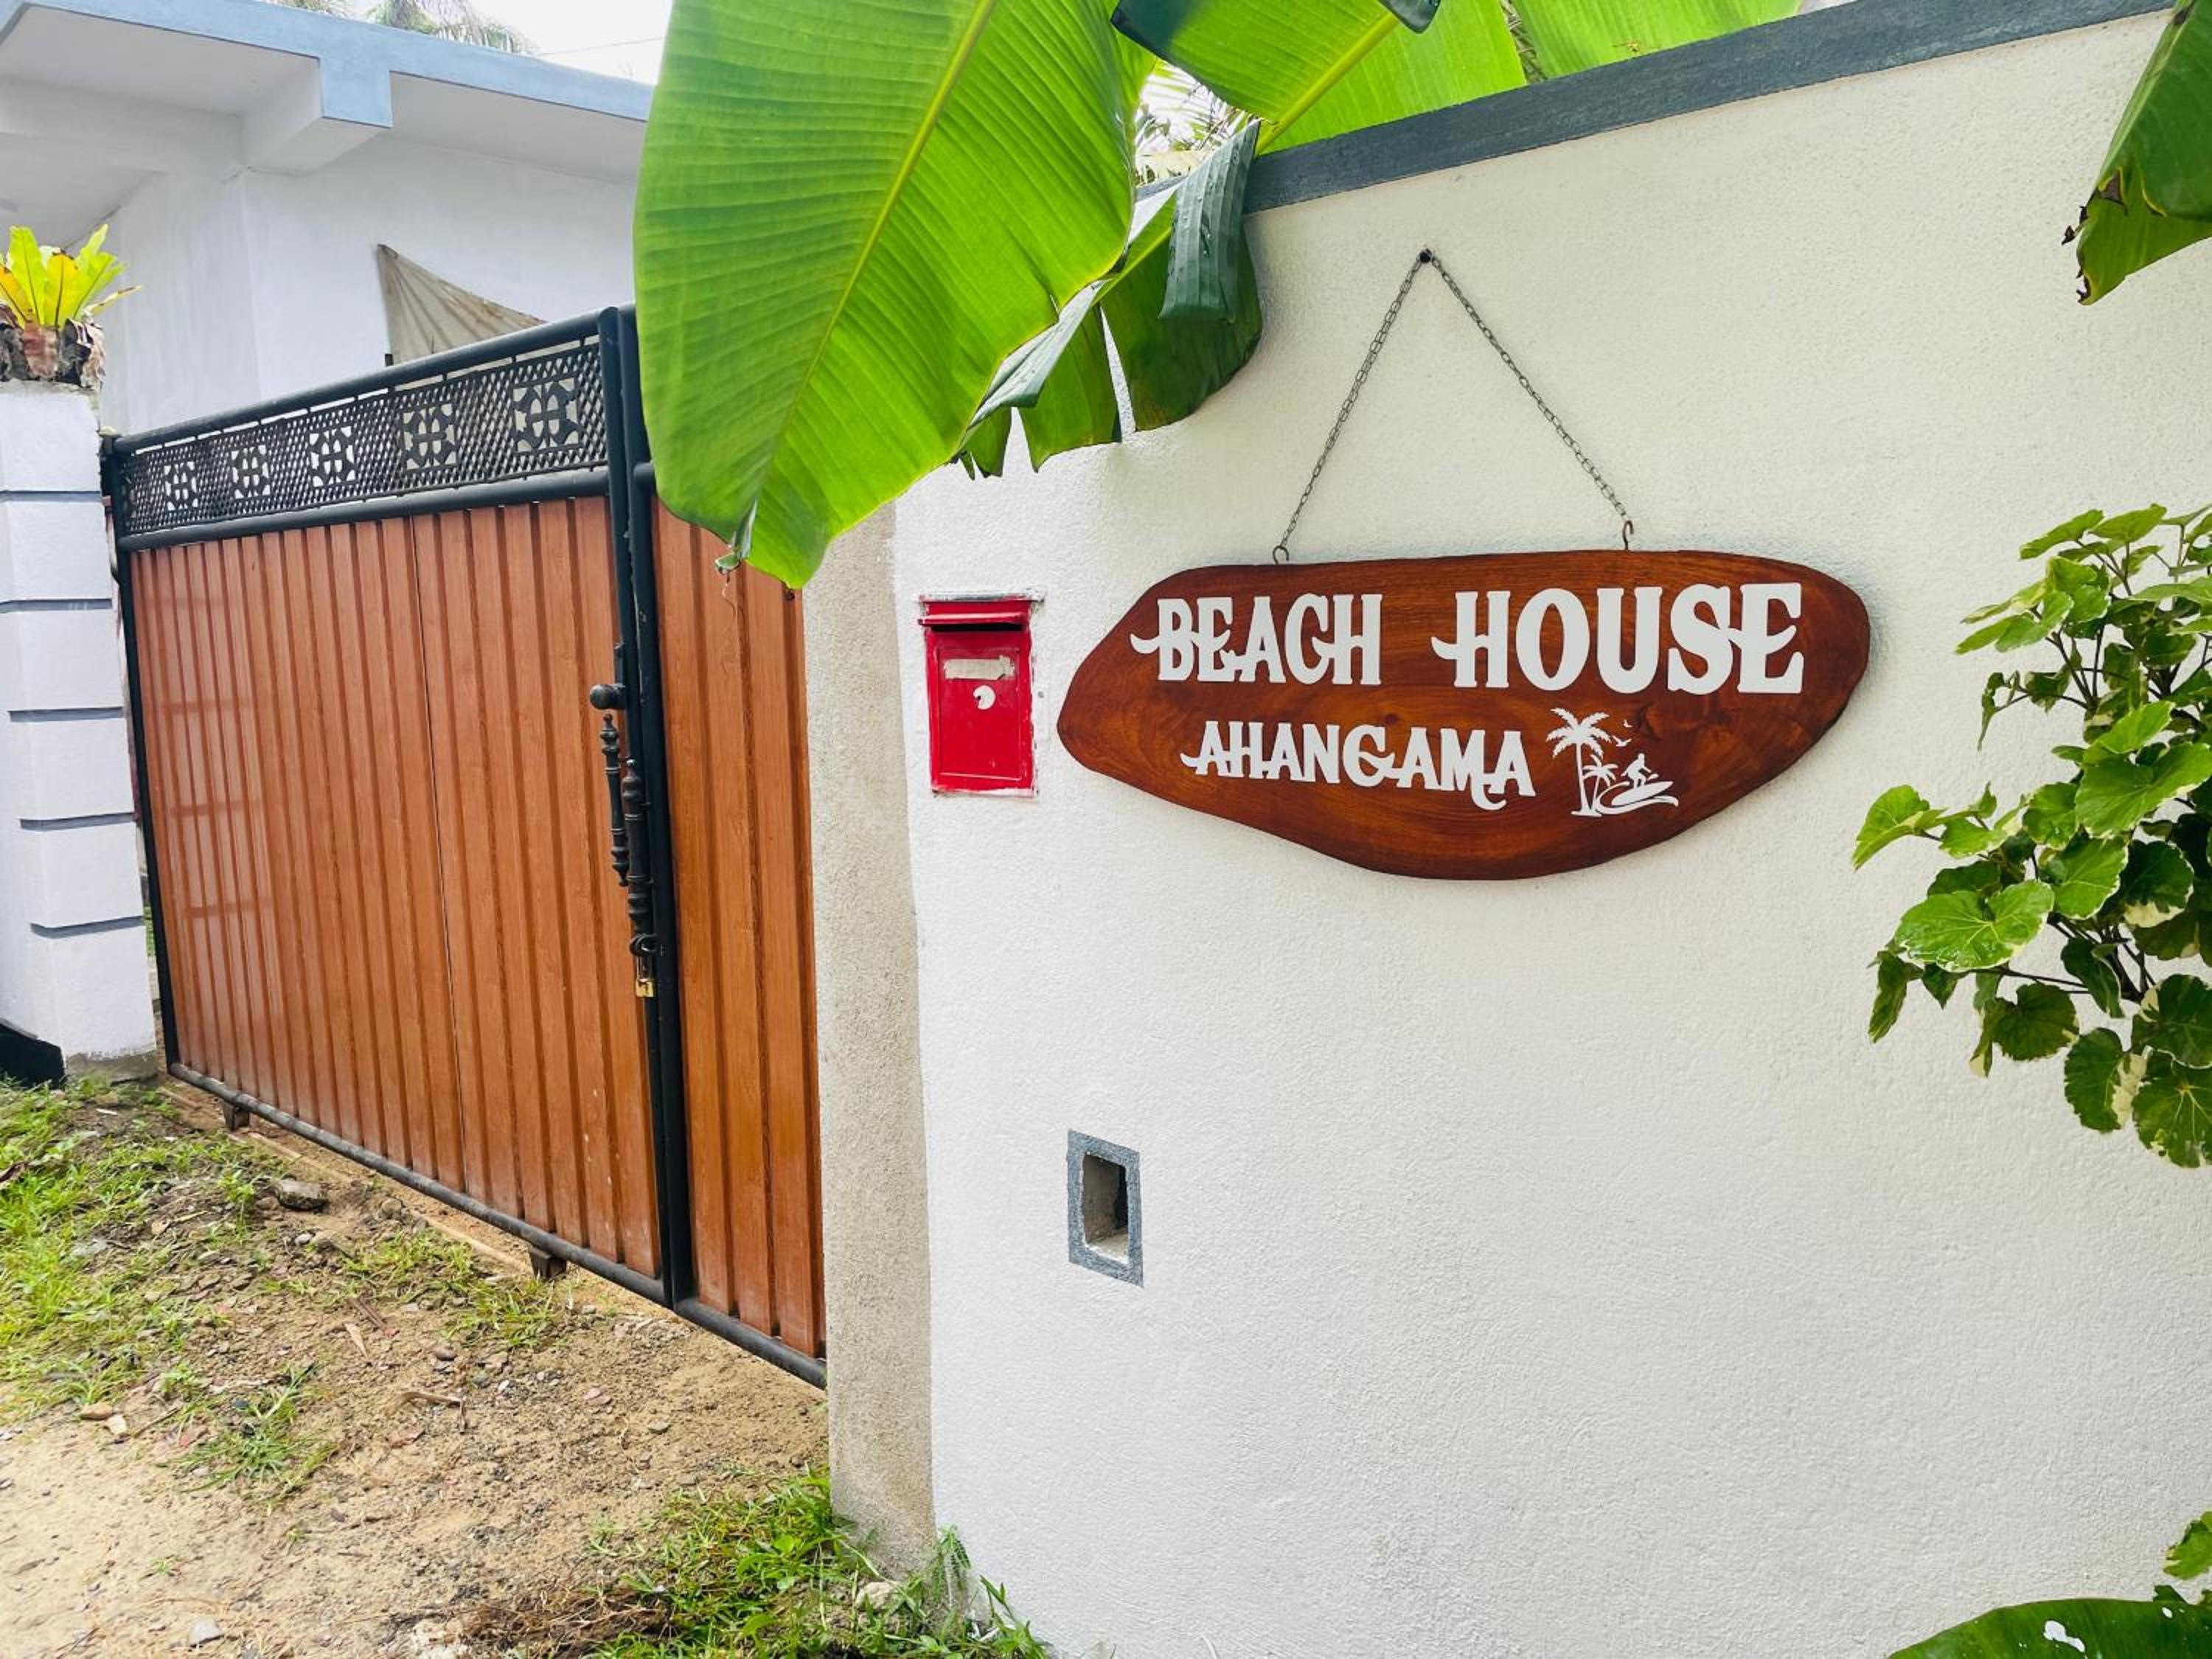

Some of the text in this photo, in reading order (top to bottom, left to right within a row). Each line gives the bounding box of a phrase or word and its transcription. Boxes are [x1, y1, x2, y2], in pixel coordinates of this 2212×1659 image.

[1130, 582, 1804, 695] BEACH HOUSE
[1180, 720, 1536, 810] AHANGAMA
